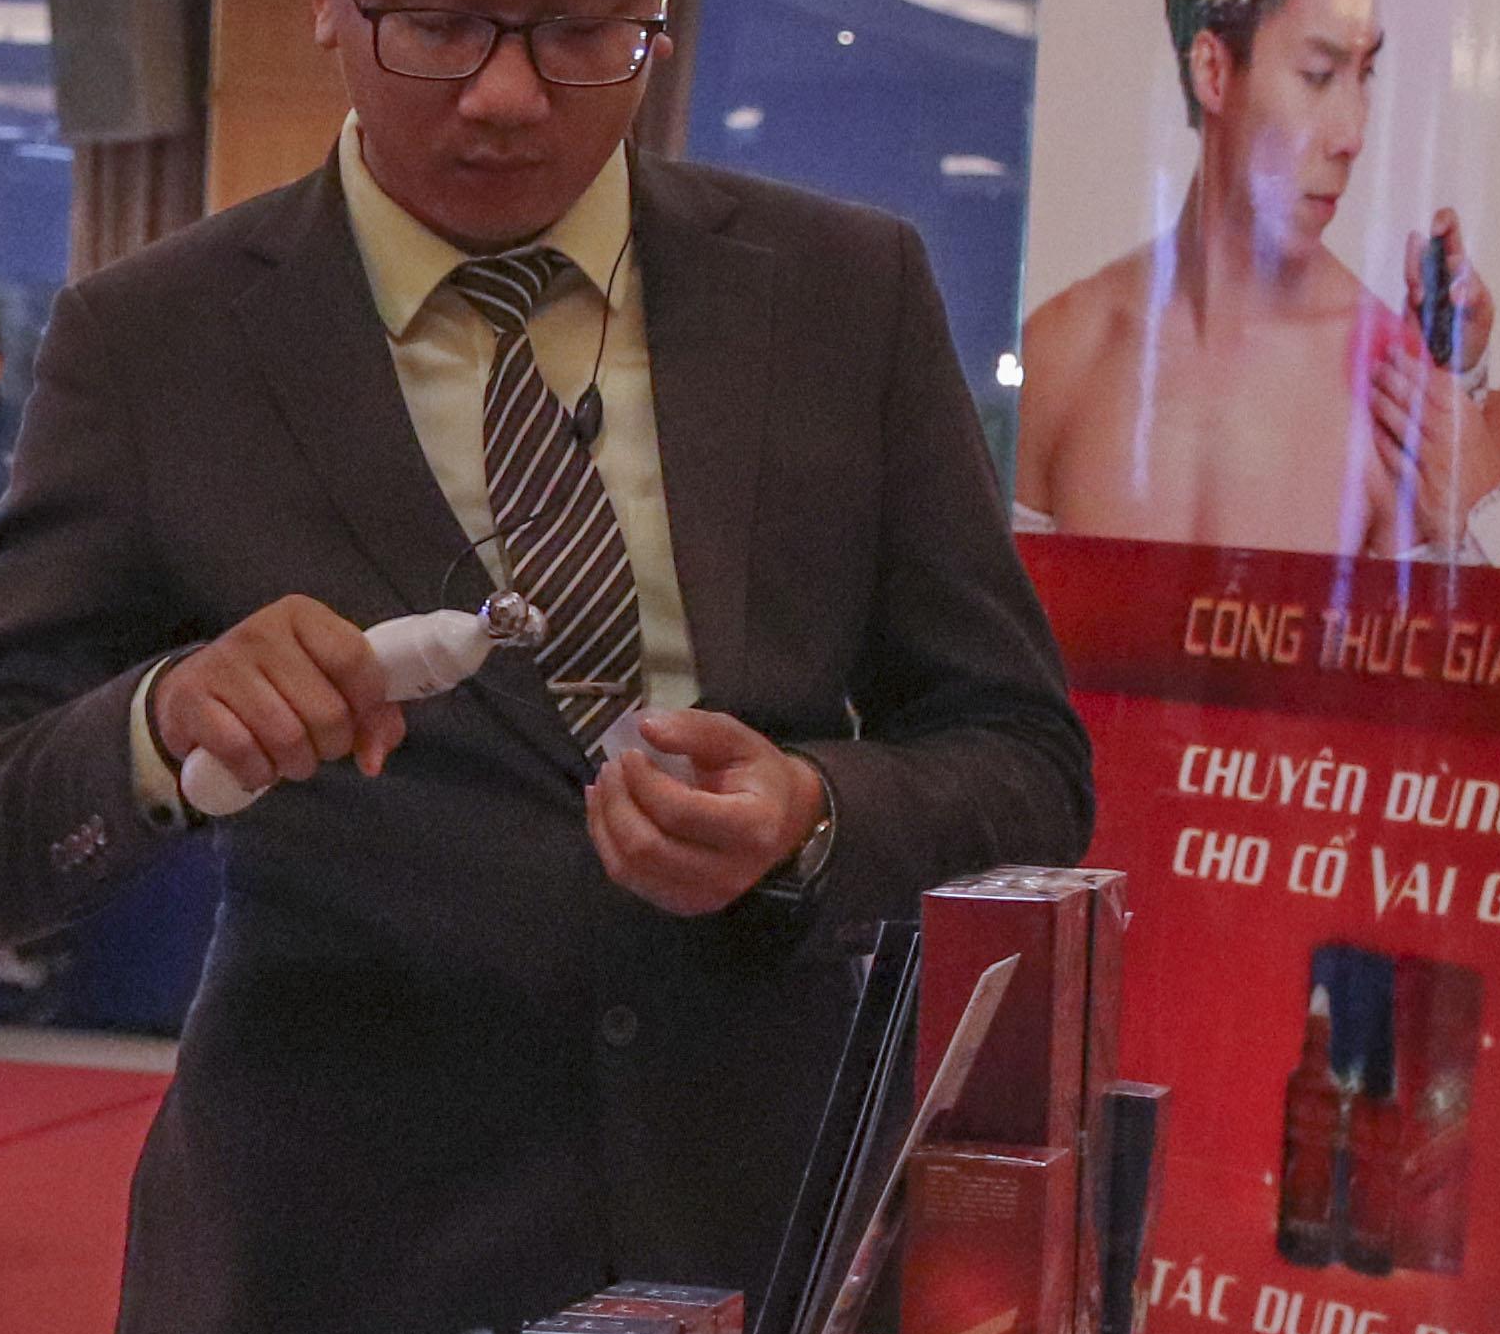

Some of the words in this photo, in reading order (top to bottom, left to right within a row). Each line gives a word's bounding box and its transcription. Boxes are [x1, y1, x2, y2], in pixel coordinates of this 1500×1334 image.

[1177, 744, 1368, 815] CHUYÊN
[1172, 827, 1271, 886] CHO
[1370, 844, 1458, 921] VAI
[1149, 1254, 1239, 1324] TÁC
